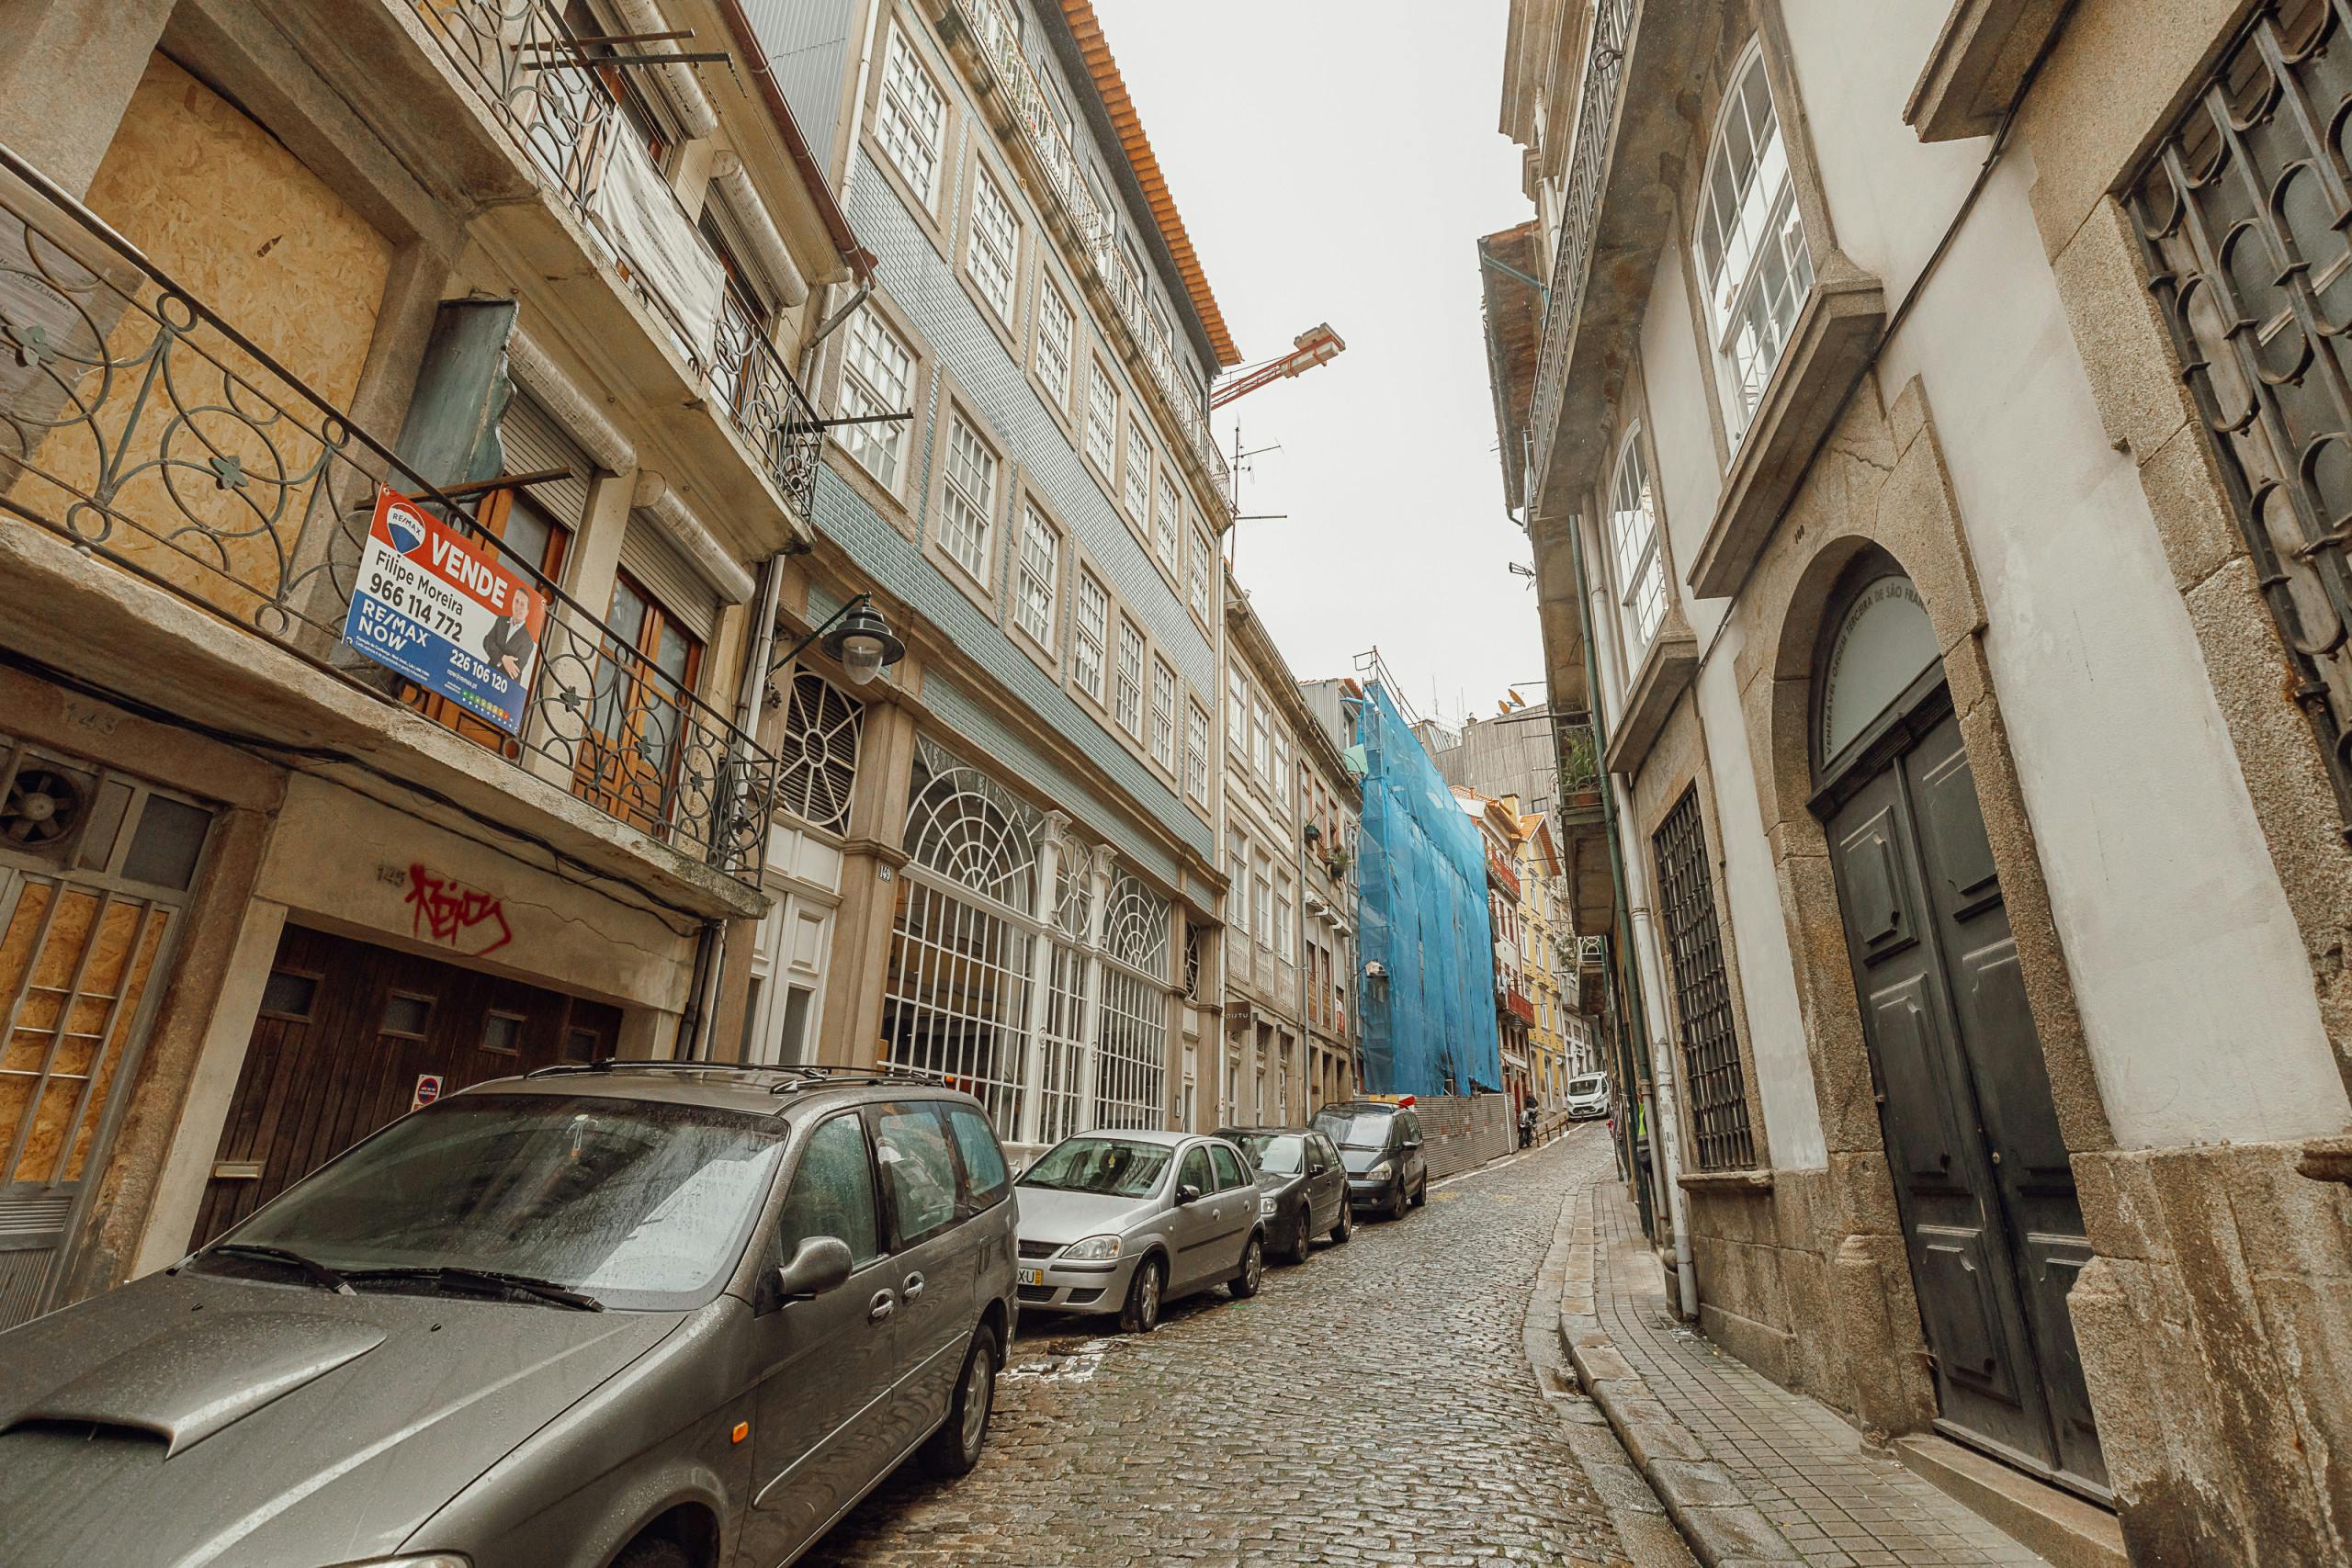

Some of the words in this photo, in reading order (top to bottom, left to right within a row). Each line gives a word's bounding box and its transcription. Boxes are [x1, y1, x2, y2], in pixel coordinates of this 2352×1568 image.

[392, 512, 422, 536] RE/MAX
[375, 548, 414, 585] Filipe
[417, 575, 463, 616] Moreira
[432, 532, 508, 609] VENDE
[362, 598, 429, 648] RE/MAX
[369, 573, 404, 608] 966
[408, 594, 432, 625] 114
[434, 610, 463, 642] 772
[1845, 596, 1873, 636] TERCEIRA
[1874, 588, 1884, 603] DE
[1885, 582, 1902, 598] SÃO
[358, 617, 408, 651] NOW
[449, 649, 471, 671] 226
[472, 661, 491, 683] 106
[491, 672, 508, 694] 120
[1018, 1269, 1035, 1283] XU
